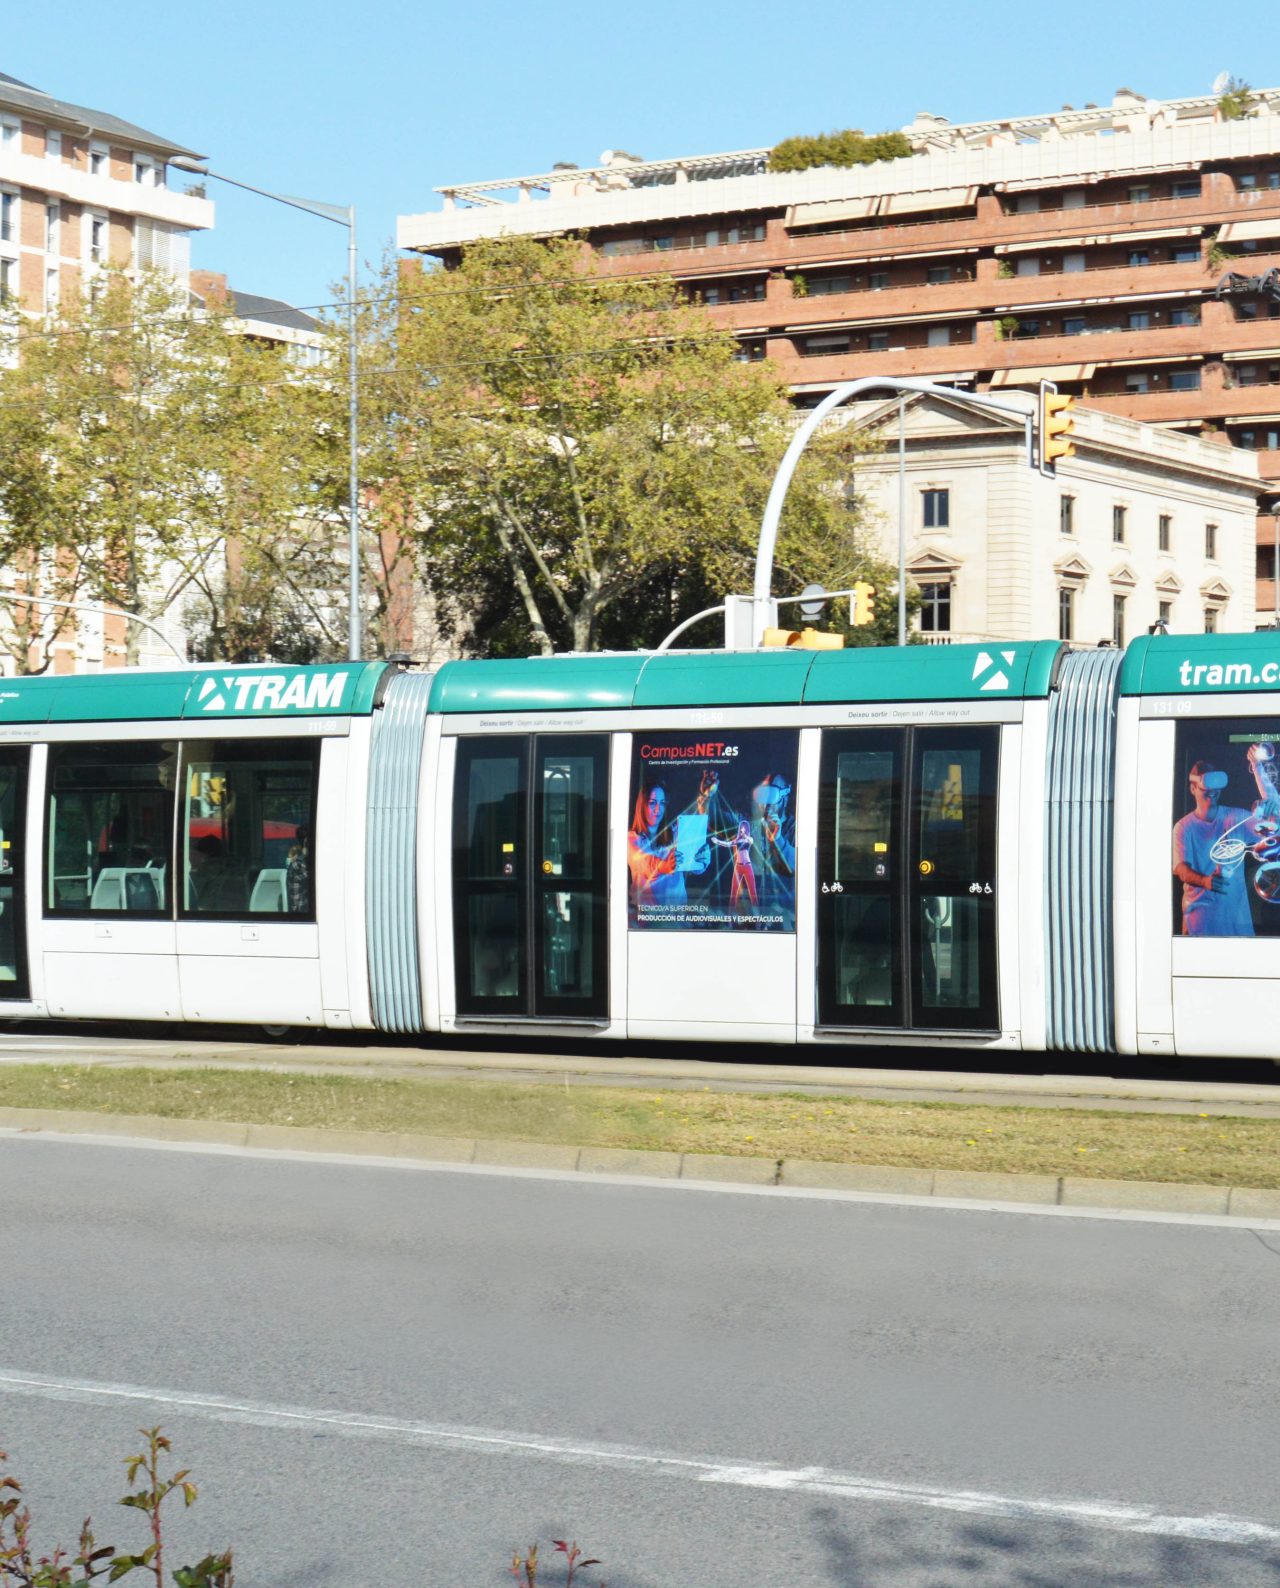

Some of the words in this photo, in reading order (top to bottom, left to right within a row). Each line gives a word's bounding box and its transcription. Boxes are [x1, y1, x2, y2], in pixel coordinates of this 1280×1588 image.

[234, 672, 349, 710] TRAM
[1152, 702, 1172, 714] 131
[1177, 701, 1192, 713] 09
[641, 742, 739, 760] CampusNET.es
[670, 904, 699, 912] SUPERIOR
[637, 914, 676, 922] PRODUCCIÓN
[676, 914, 685, 922] DE
[685, 915, 731, 923] AUDIOVISUALES
[737, 915, 784, 923] ESPECTÁCULOS
